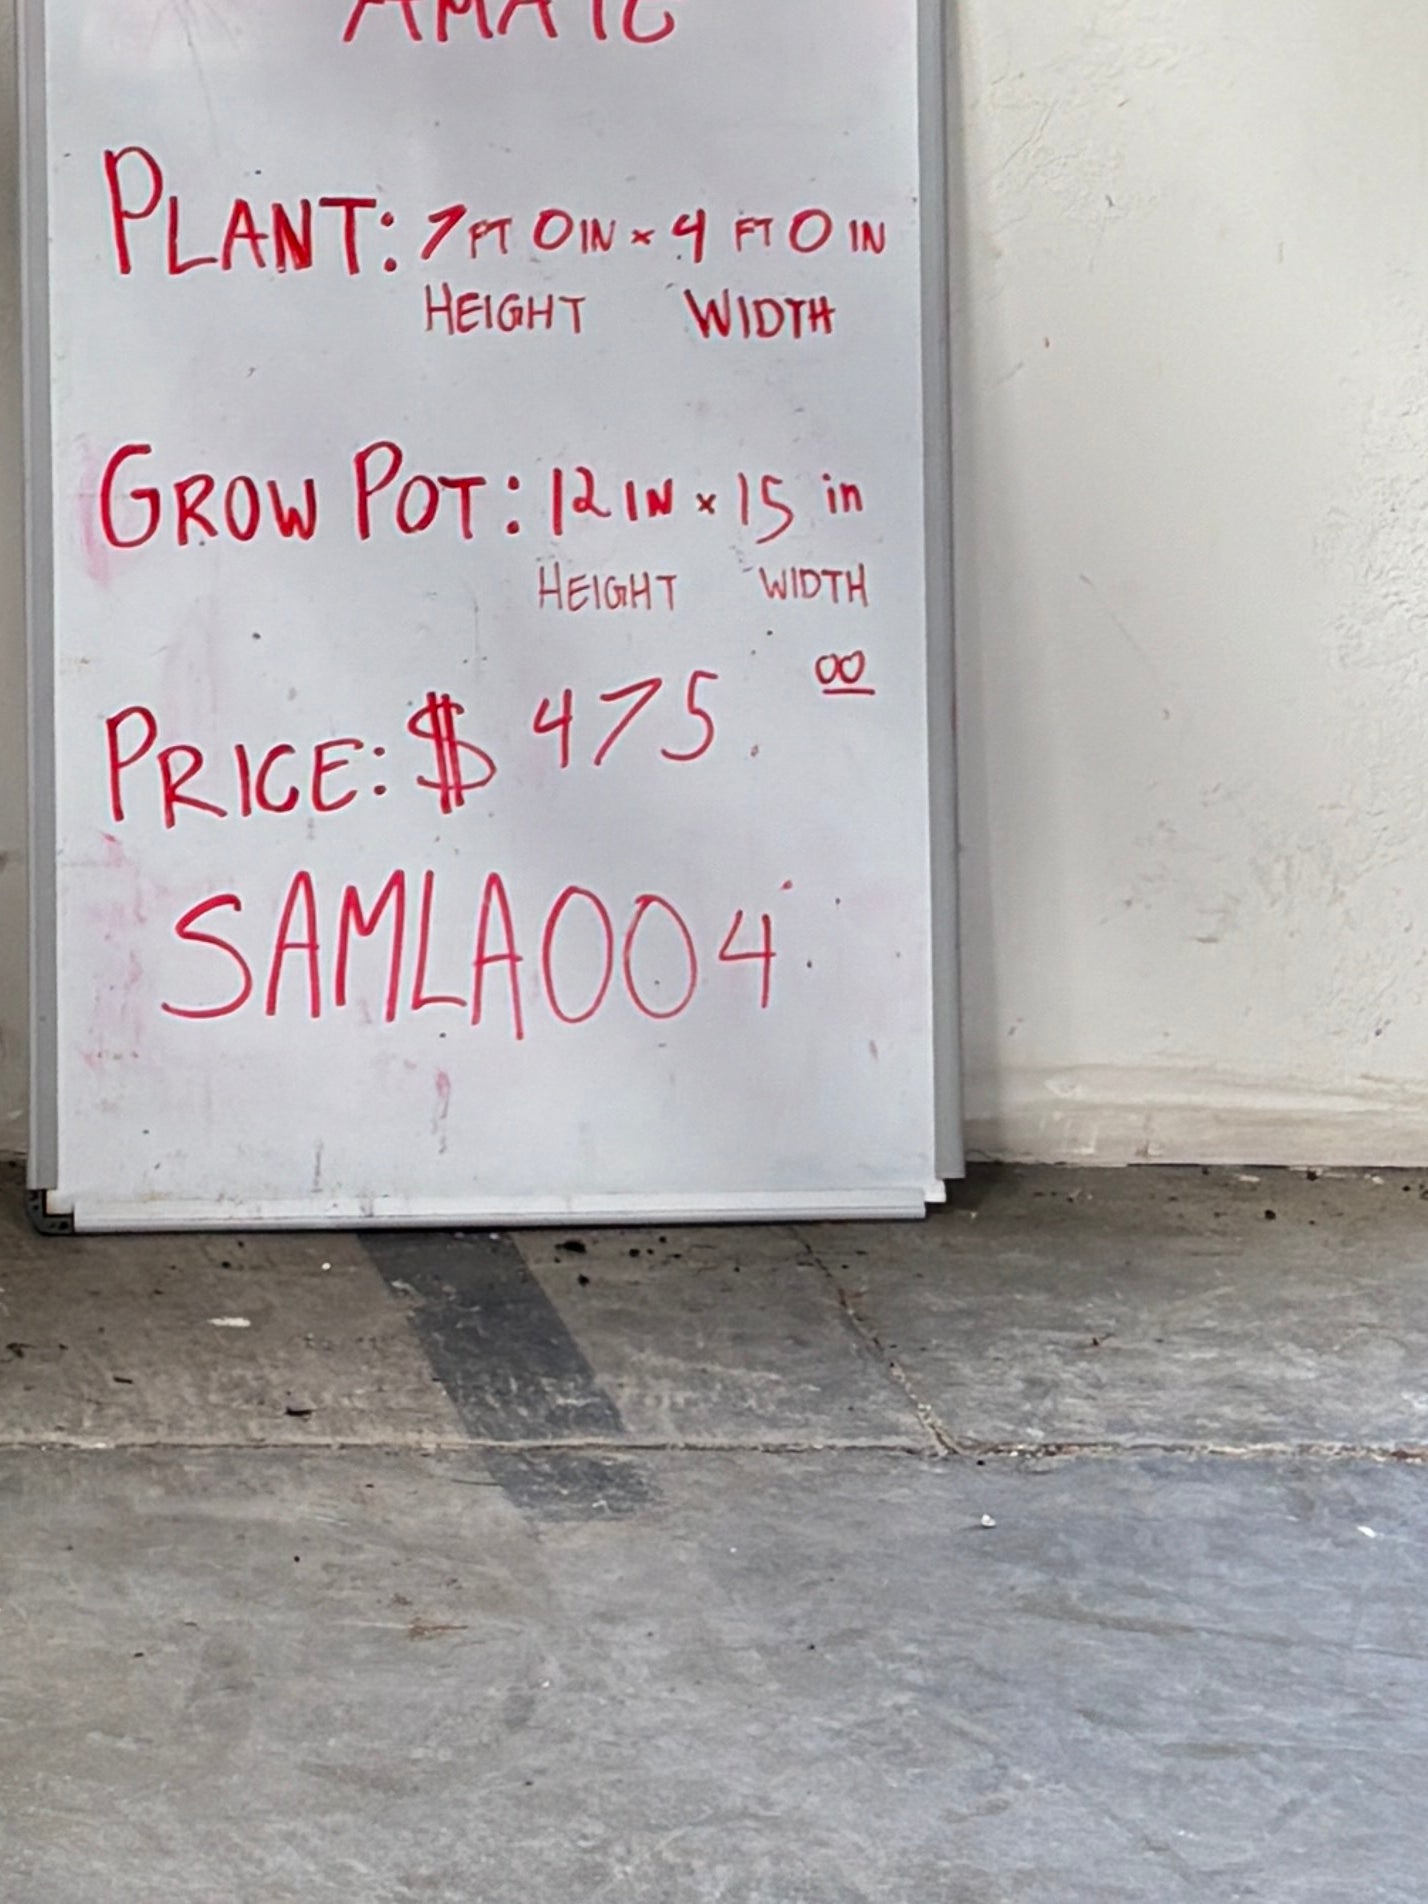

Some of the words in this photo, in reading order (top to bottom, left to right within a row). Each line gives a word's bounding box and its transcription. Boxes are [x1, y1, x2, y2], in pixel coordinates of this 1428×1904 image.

[102, 146, 398, 277] PLANT:
[424, 282, 586, 335] HEIGHT
[684, 288, 835, 340] WIDTH
[97, 442, 318, 551] GROW
[351, 440, 520, 541] POT:
[550, 465, 612, 537] 12
[624, 477, 674, 523] IN
[738, 471, 794, 543] 15
[538, 564, 677, 611] HEIGHT
[757, 564, 870, 606] WIDTH
[104, 705, 386, 829] PRICE:
[161, 869, 777, 1041] SAMLA004
